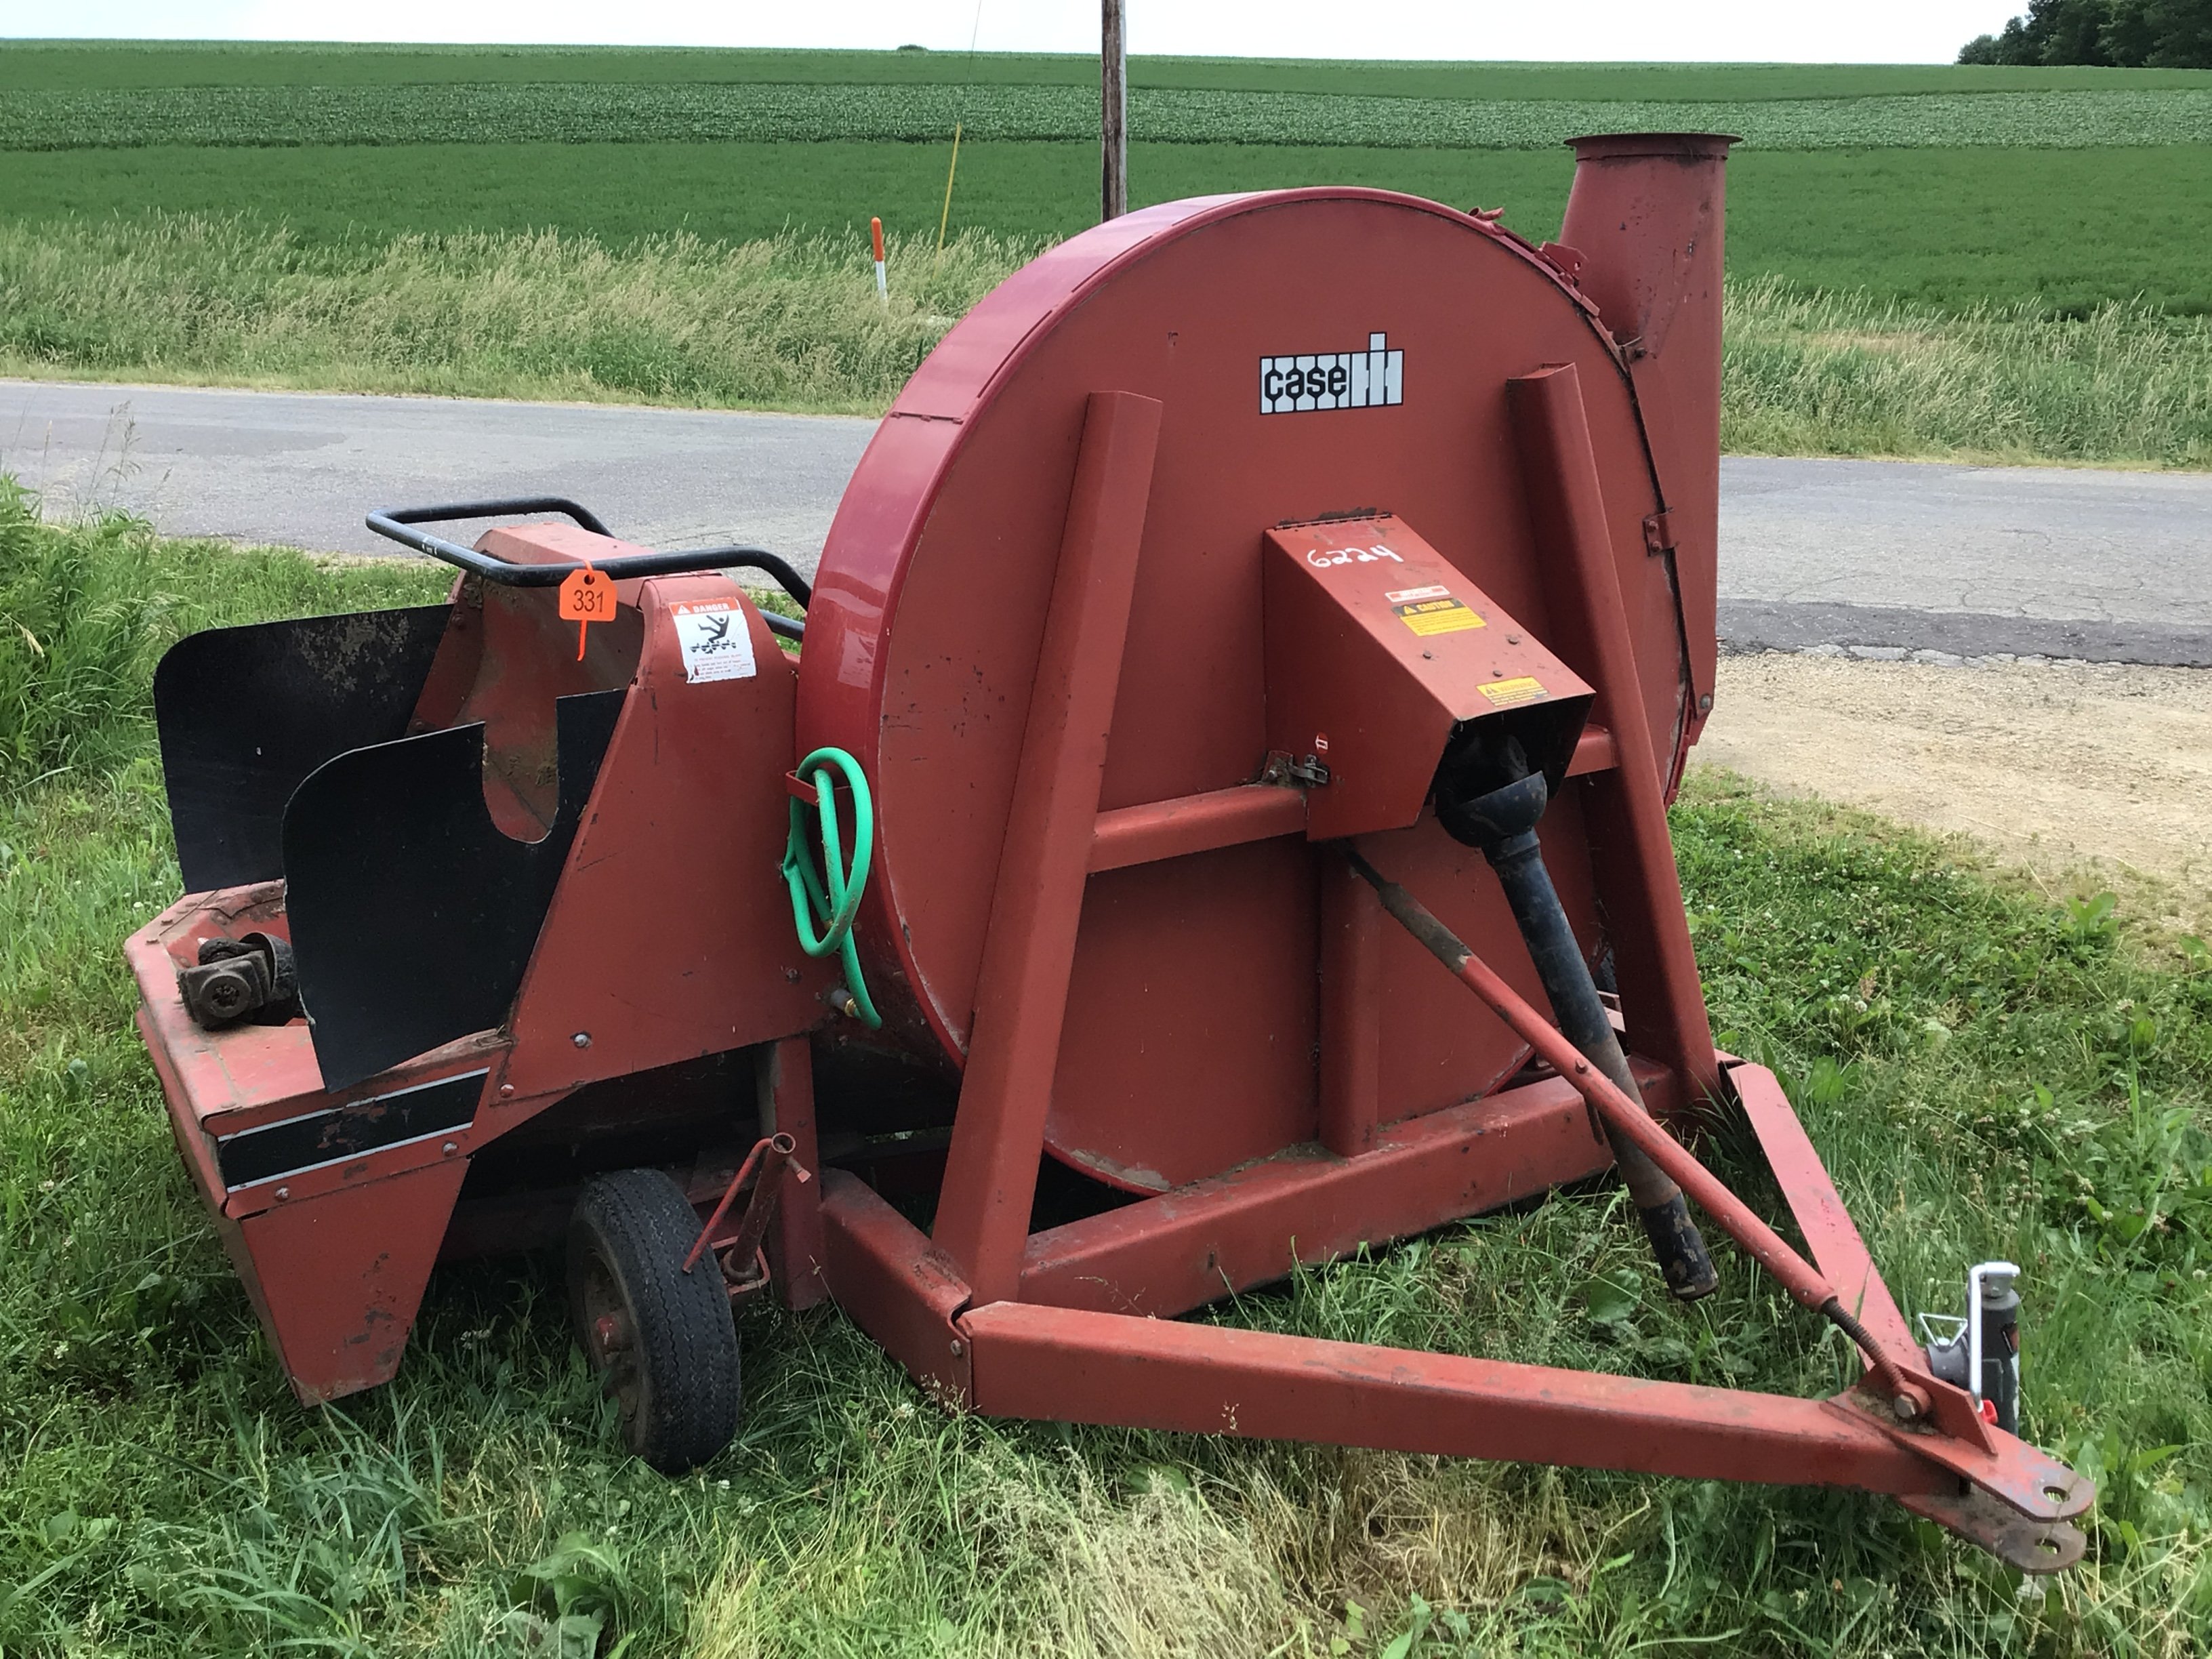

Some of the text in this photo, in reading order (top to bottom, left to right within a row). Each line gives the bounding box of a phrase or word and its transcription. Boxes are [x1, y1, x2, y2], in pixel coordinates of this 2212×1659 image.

[1264, 365, 1347, 403] case
[1307, 544, 1404, 568] 6224
[573, 589, 604, 613] 331
[692, 602, 730, 613] DANGER
[1416, 600, 1455, 612] CAUTION
